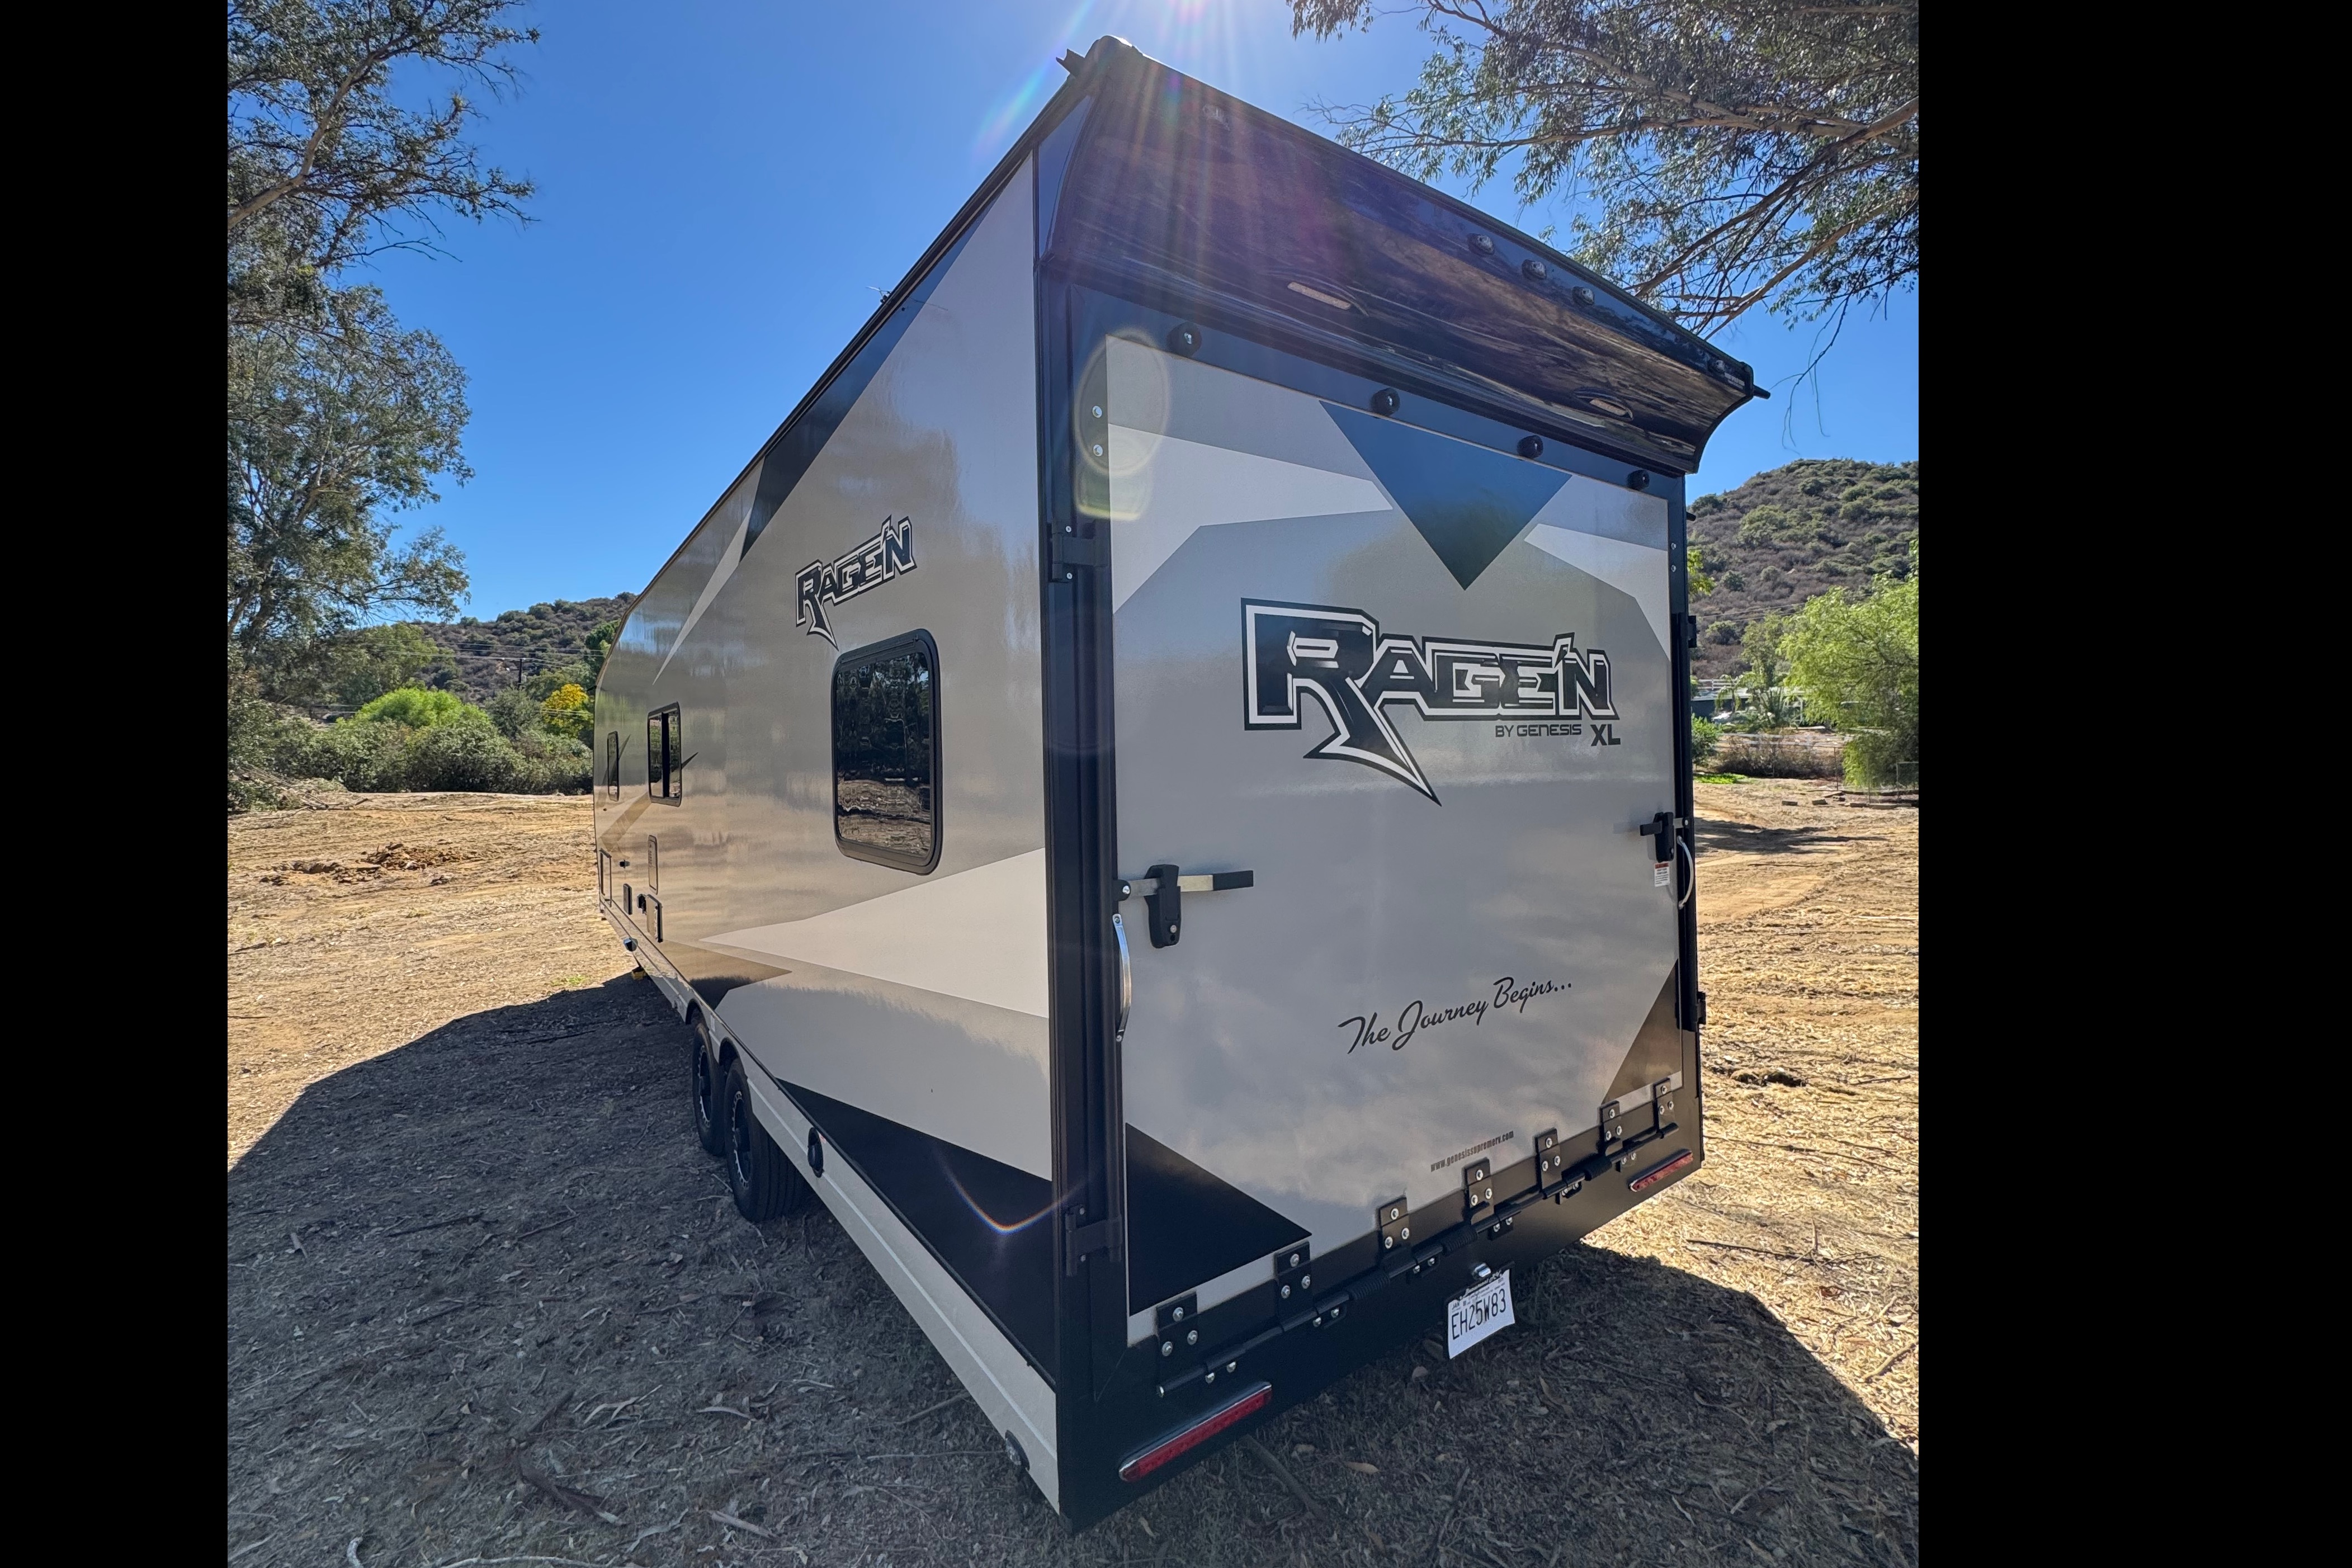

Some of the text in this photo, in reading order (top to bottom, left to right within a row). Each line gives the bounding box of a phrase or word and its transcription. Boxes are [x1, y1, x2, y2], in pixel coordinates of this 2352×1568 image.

[1495, 724, 1581, 738] BY GENESIS
[1590, 724, 1621, 747] XL
[1338, 976, 1571, 1054] The Journey Begins...
[1430, 1131, 1514, 1172] www.genesissupremerv.com
[1452, 1288, 1506, 1340] EH25W83
